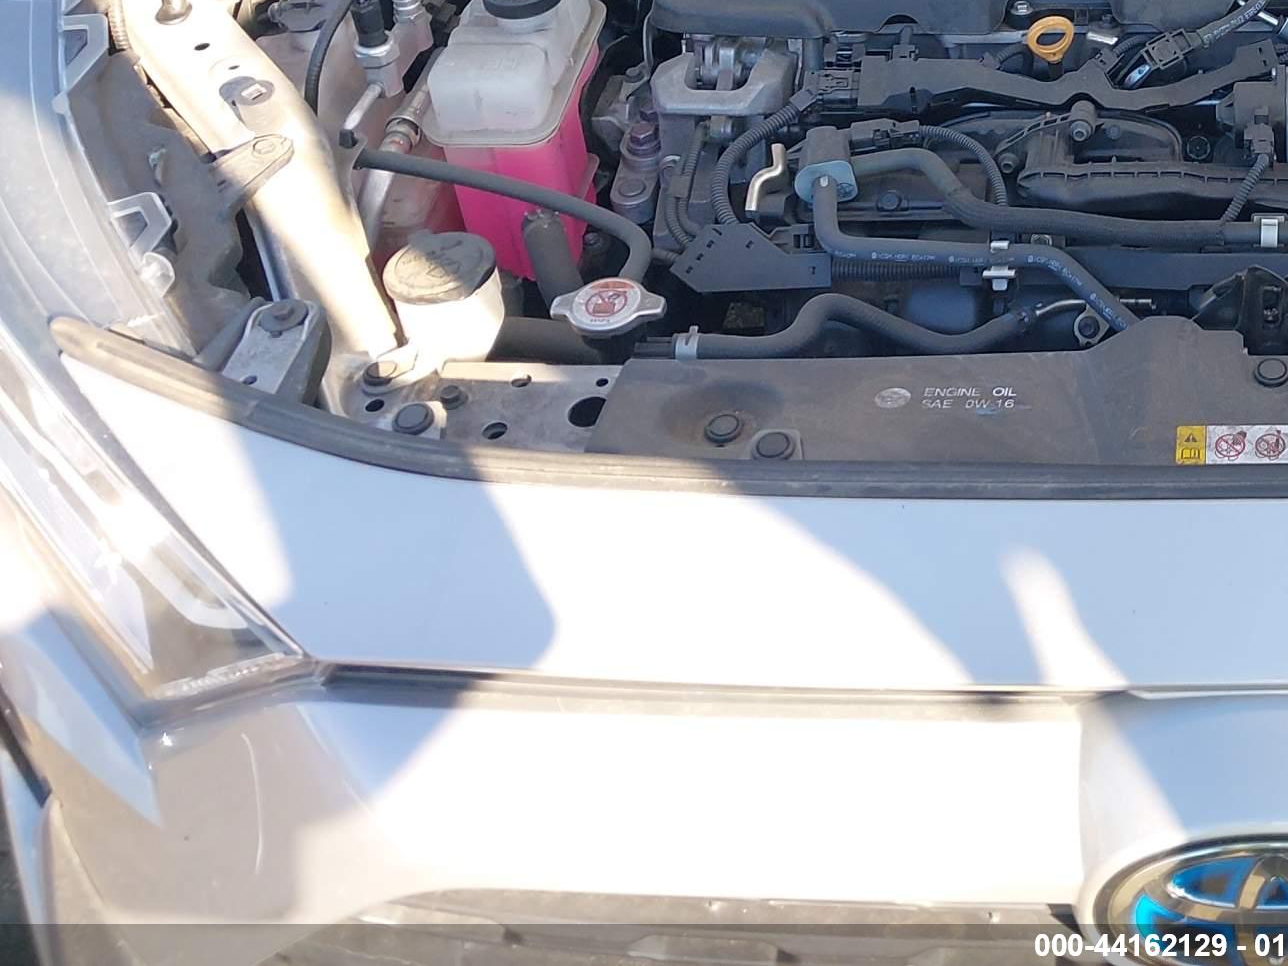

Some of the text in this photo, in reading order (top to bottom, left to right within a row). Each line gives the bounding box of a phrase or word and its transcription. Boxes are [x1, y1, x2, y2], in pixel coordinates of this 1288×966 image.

[923, 386, 1017, 397] ENGINE OIL
[921, 398, 954, 409] SAE
